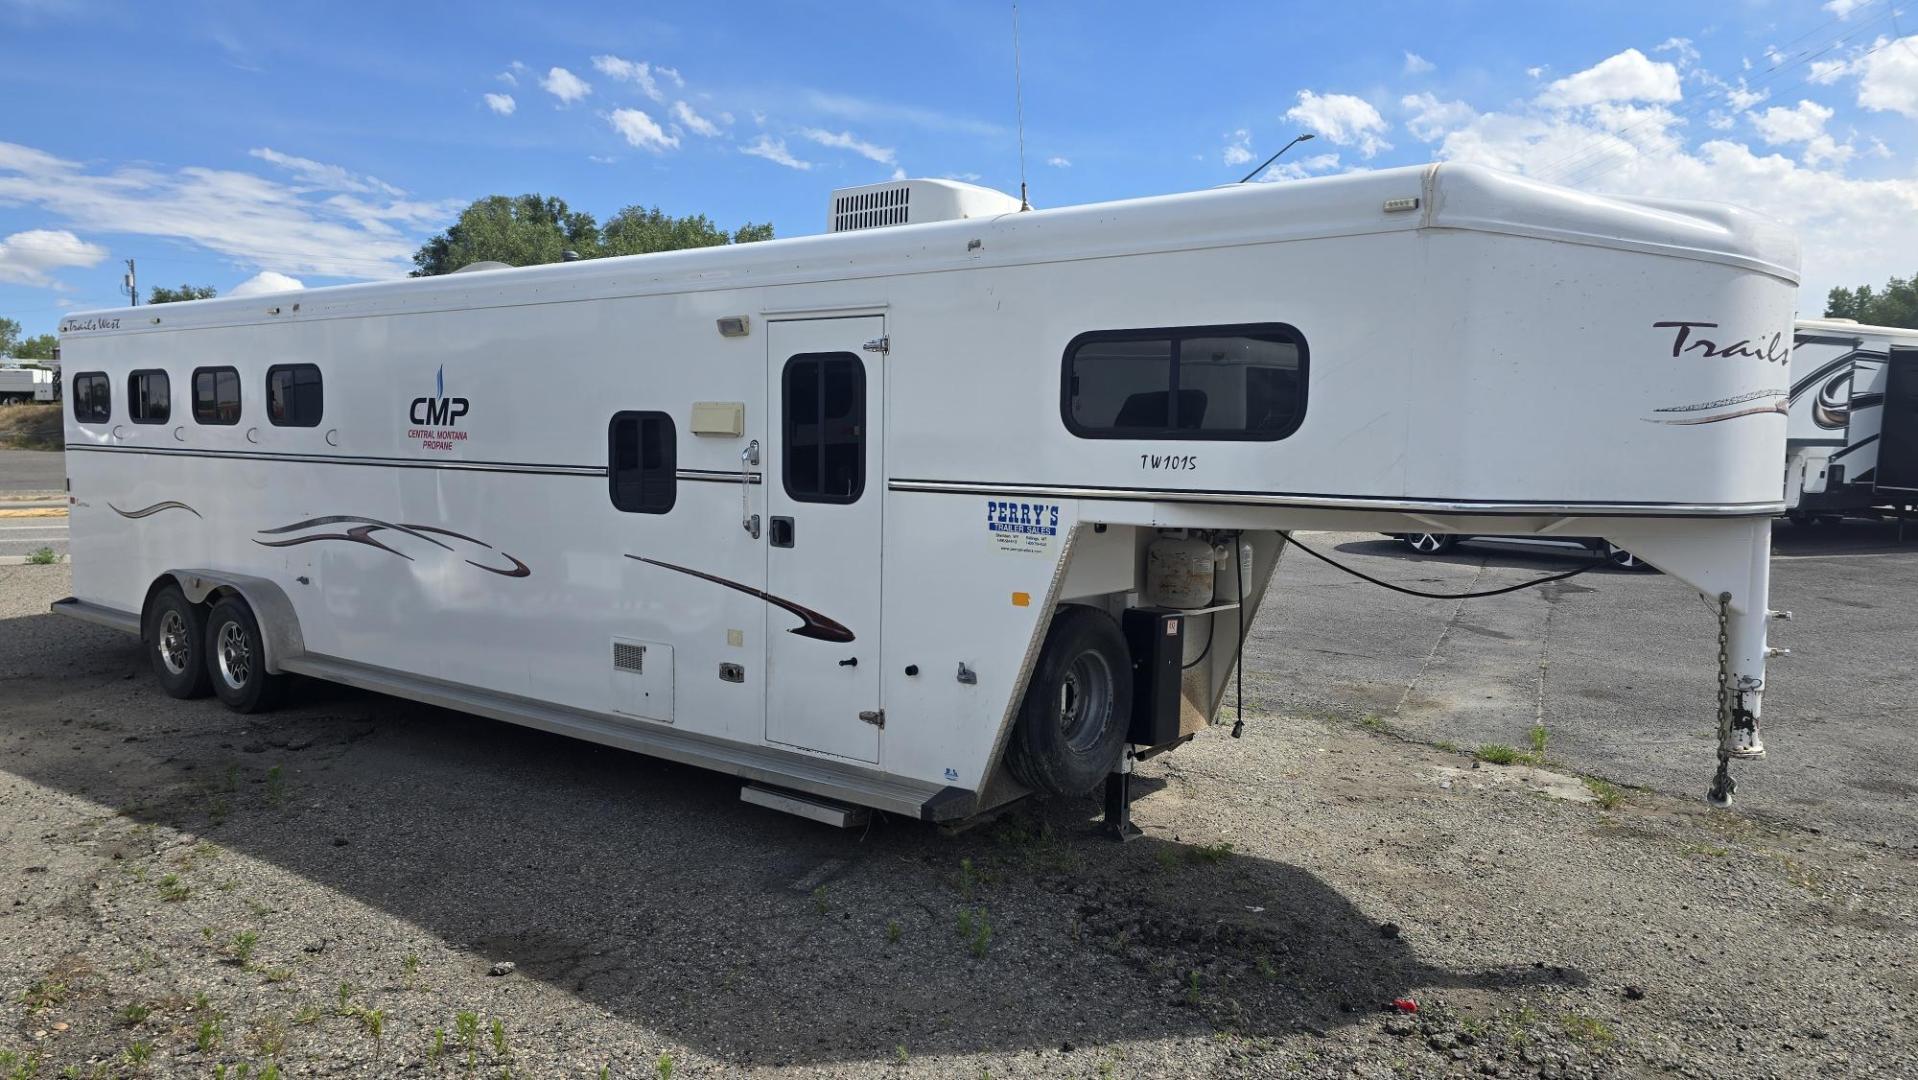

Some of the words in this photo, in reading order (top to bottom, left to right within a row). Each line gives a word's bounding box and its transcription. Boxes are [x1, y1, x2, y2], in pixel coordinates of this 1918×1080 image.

[67, 319, 97, 331] Trails
[98, 318, 120, 329] West
[1652, 321, 1789, 366] Trails
[409, 397, 470, 426] CMP
[408, 429, 435, 439] CENTRAL
[437, 431, 468, 440] MONTANA
[423, 440, 453, 450] PROPANE
[1141, 454, 1197, 470] TW1015
[987, 501, 1059, 526] PERRY'S
[995, 523, 1024, 533] TRAILER
[1026, 526, 1051, 535] SALES
